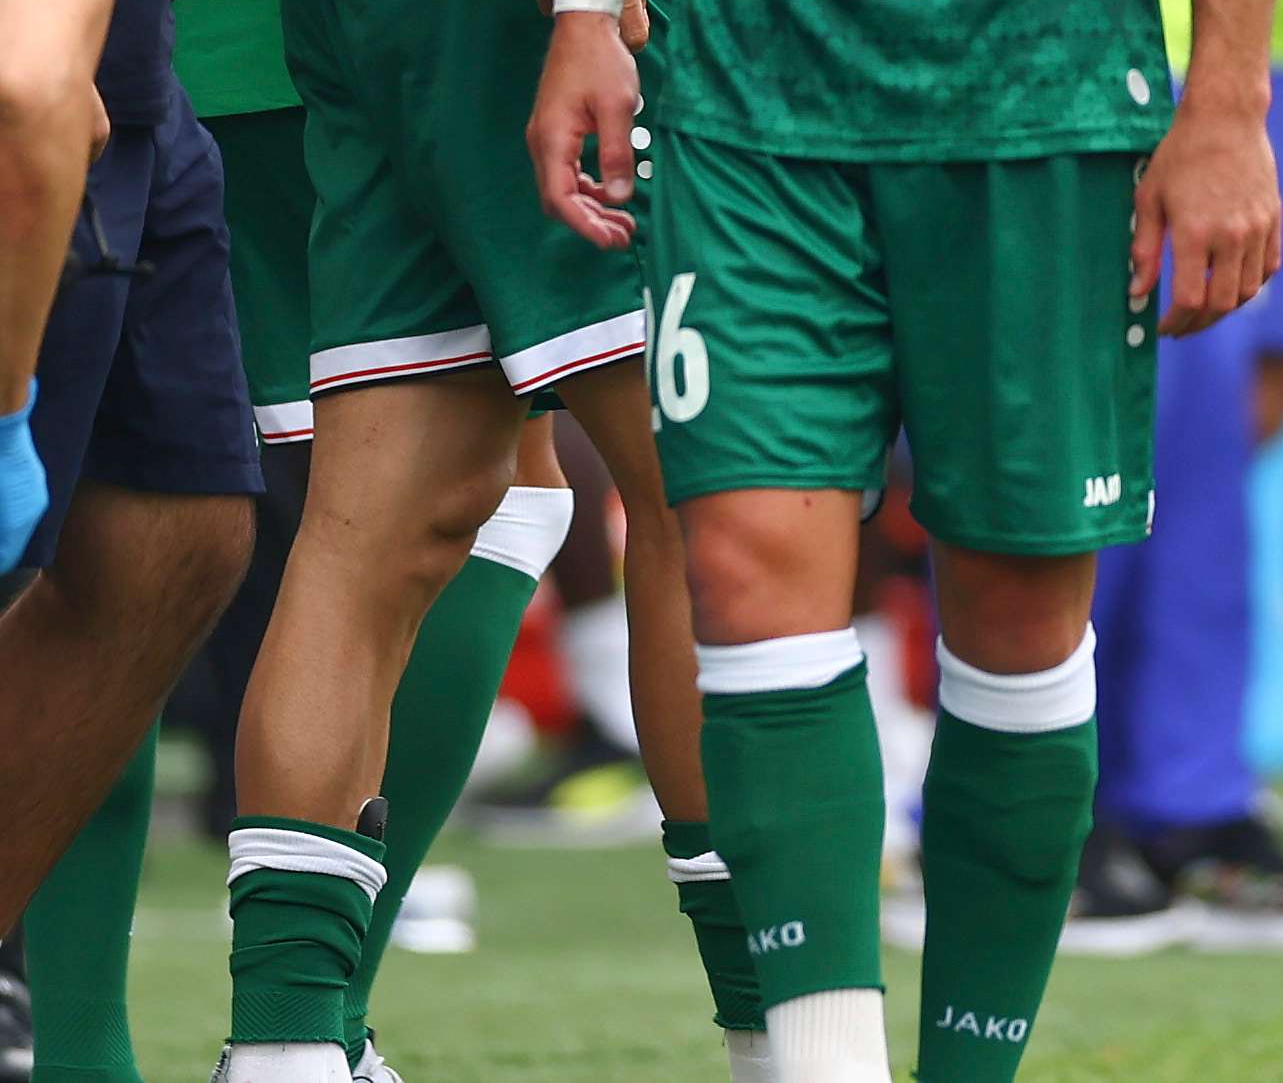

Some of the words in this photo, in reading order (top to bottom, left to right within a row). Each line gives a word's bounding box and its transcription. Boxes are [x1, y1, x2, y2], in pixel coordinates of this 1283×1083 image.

[643, 272, 710, 432] 6
[747, 921, 806, 955] AKO
[936, 1006, 1028, 1043] JAKO
